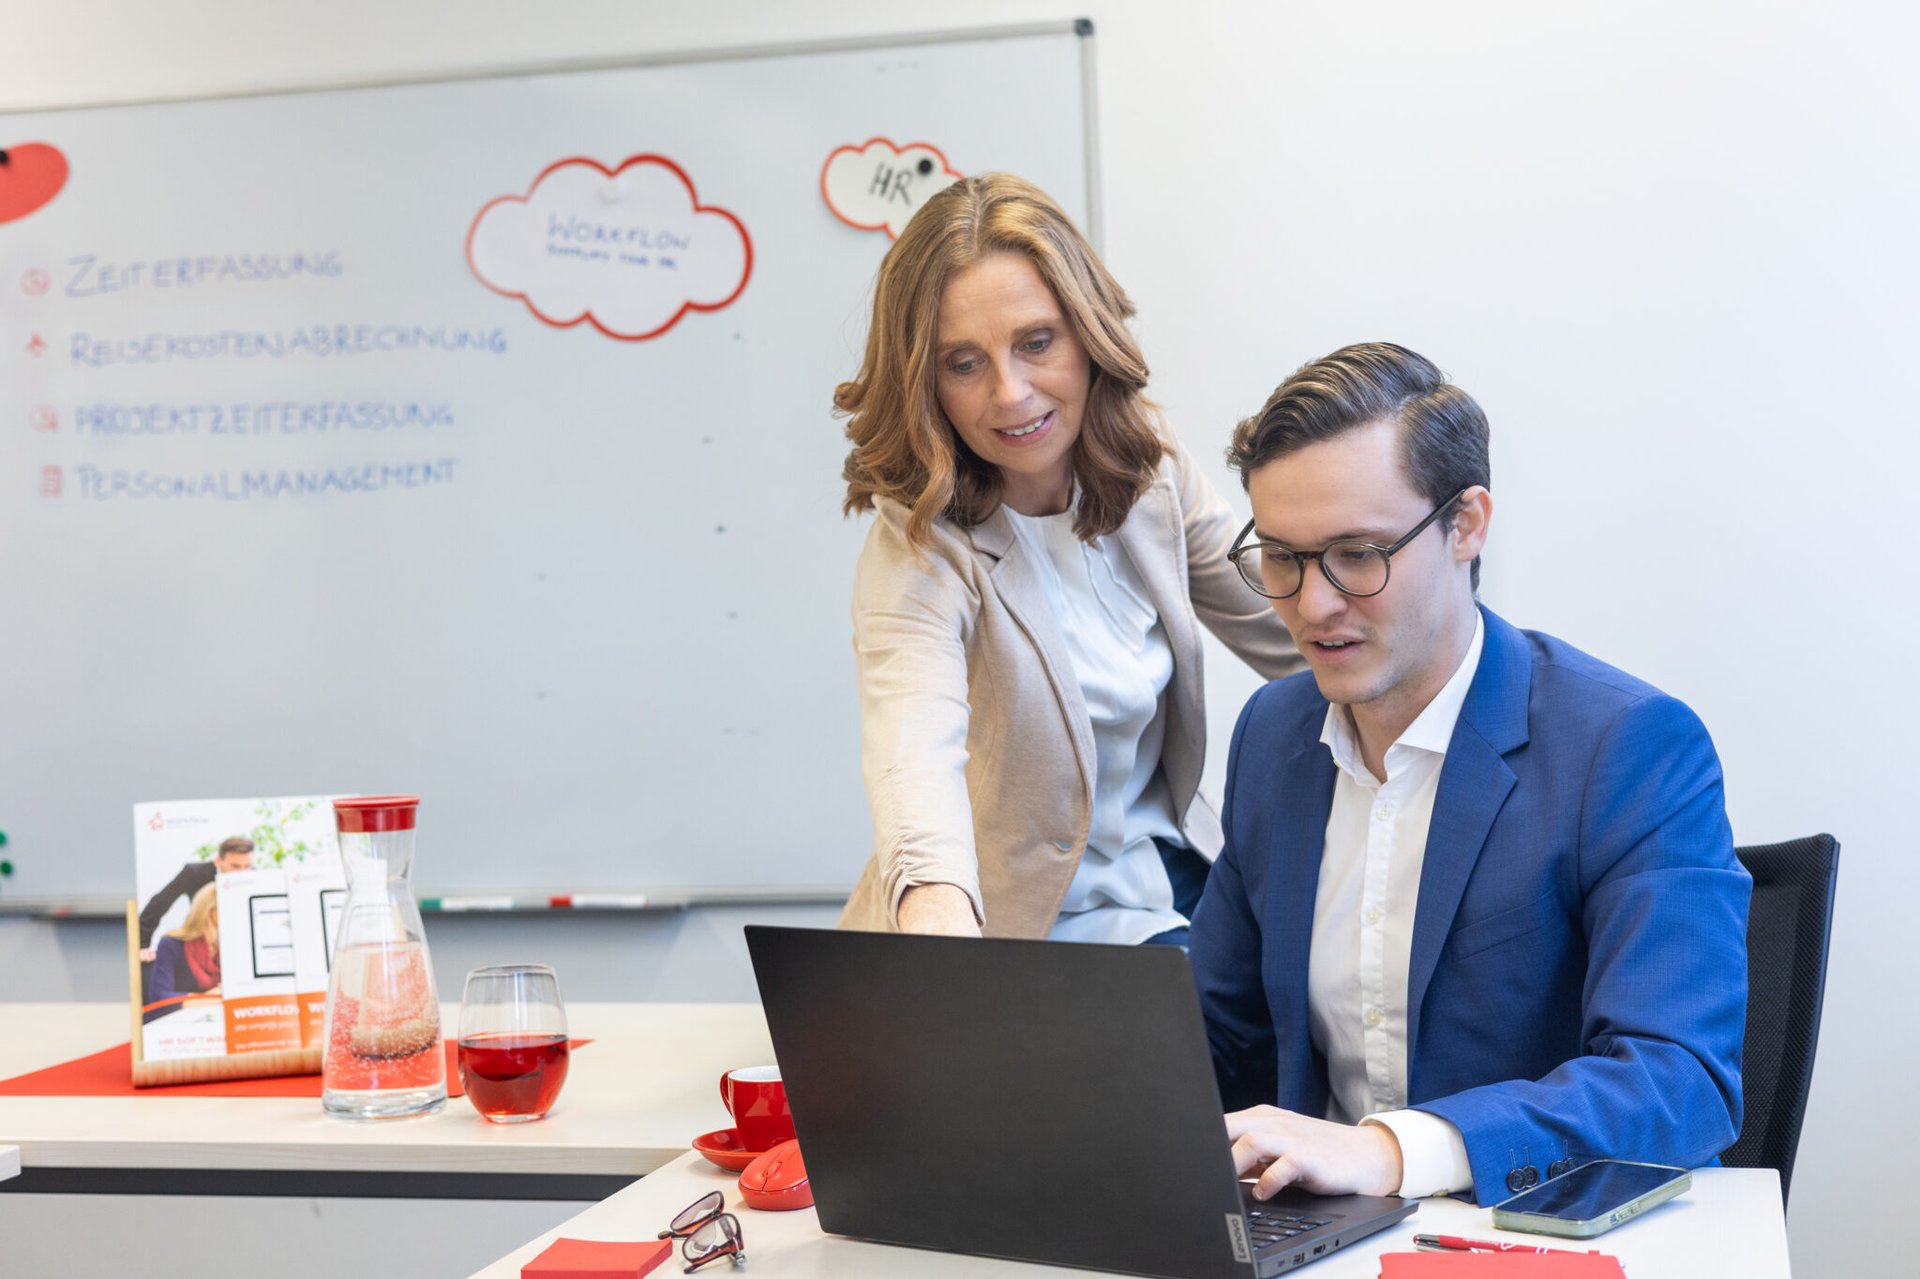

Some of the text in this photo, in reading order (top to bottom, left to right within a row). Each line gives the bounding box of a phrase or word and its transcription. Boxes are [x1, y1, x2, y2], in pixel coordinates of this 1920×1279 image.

[869, 161, 912, 207] HR
[548, 213, 690, 250] WORKFLOW
[70, 323, 508, 367] REISEKOSTENABRECHNUNG
[75, 402, 454, 435] PROJEKTZEITERFASSUNG
[75, 459, 455, 500] PERSONALMANAGEMENT
[1232, 1217, 1247, 1259] Lenovo
